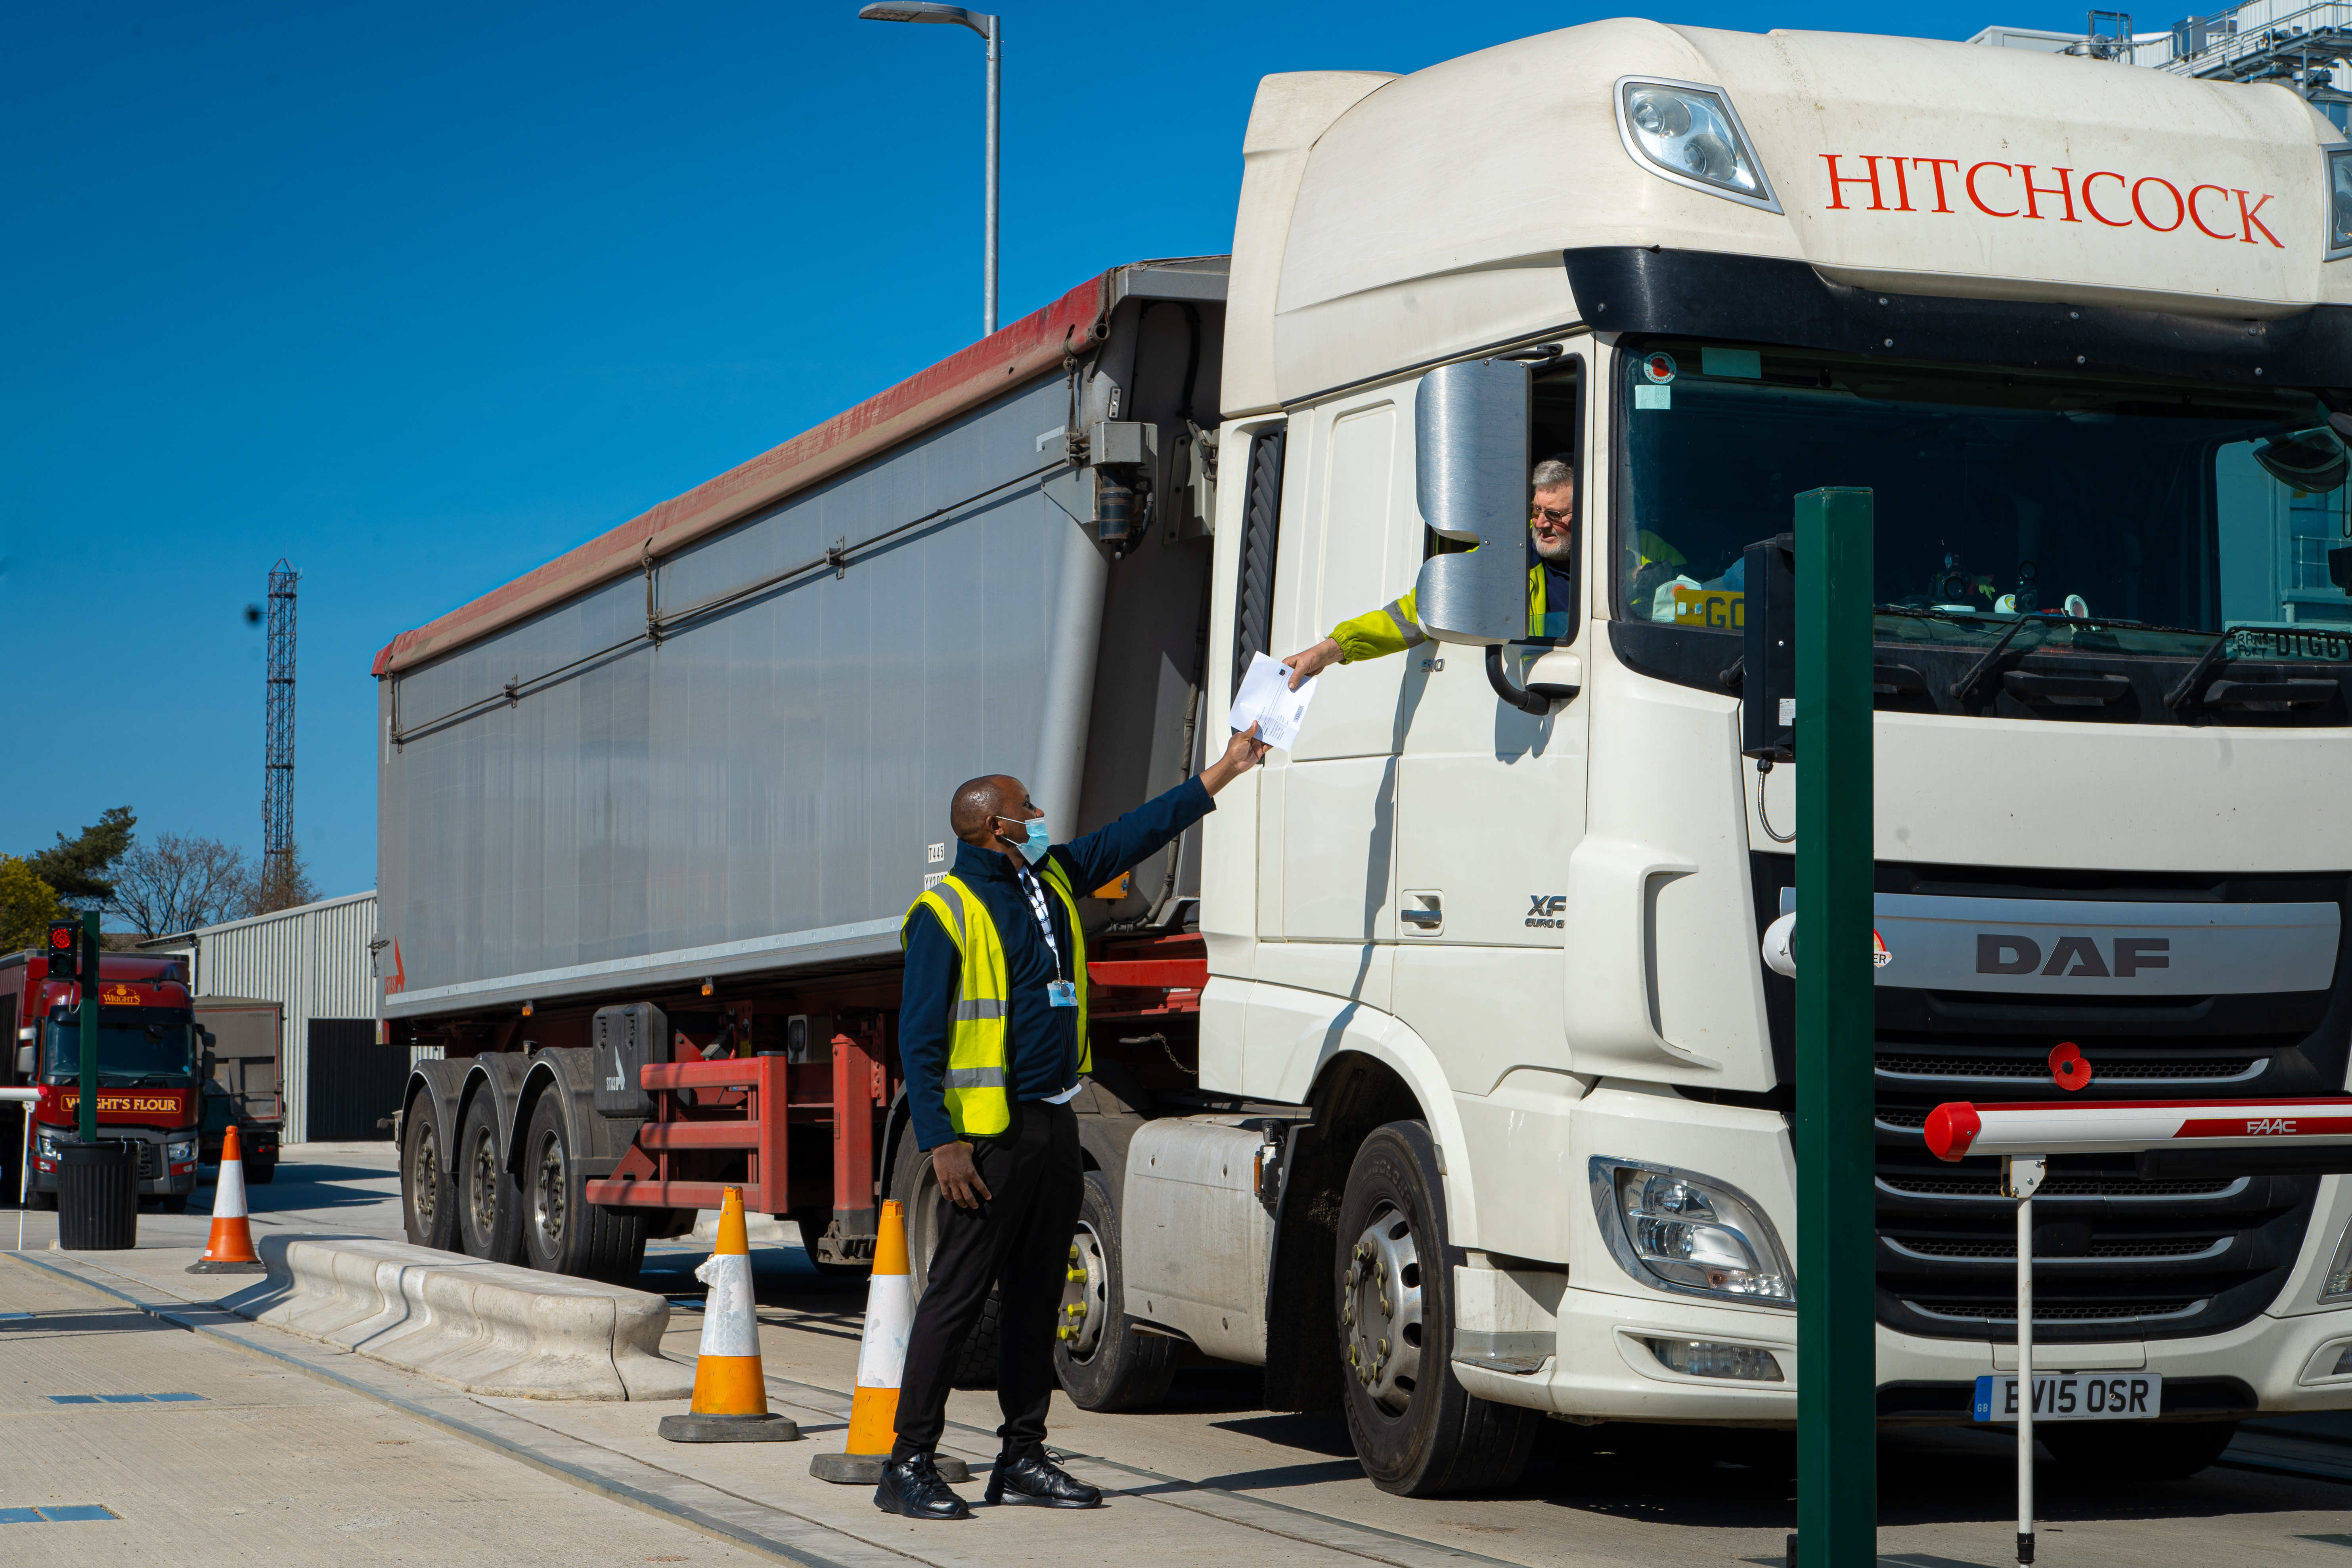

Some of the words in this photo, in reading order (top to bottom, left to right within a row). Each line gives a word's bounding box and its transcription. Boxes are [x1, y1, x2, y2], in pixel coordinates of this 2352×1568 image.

[1818, 153, 2285, 249] HITCHCOCK
[1651, 353, 1674, 364] SUPPORTING
[1665, 369, 1675, 381] APPEAL
[1420, 659, 1445, 673] 510
[929, 845, 943, 860] T445
[1527, 895, 1567, 917] XF
[1556, 919, 1565, 929] 6
[1976, 933, 2170, 977] DAF
[103, 994, 140, 1003] WRIGHT'S
[606, 1076, 616, 1091] STAS
[66, 1097, 130, 1110] WGHT'S
[134, 1099, 176, 1110] FLOUR
[2247, 1119, 2296, 1134] FAAC
[2087, 1379, 2149, 1413] OSR
[1977, 1403, 1988, 1412] GB
